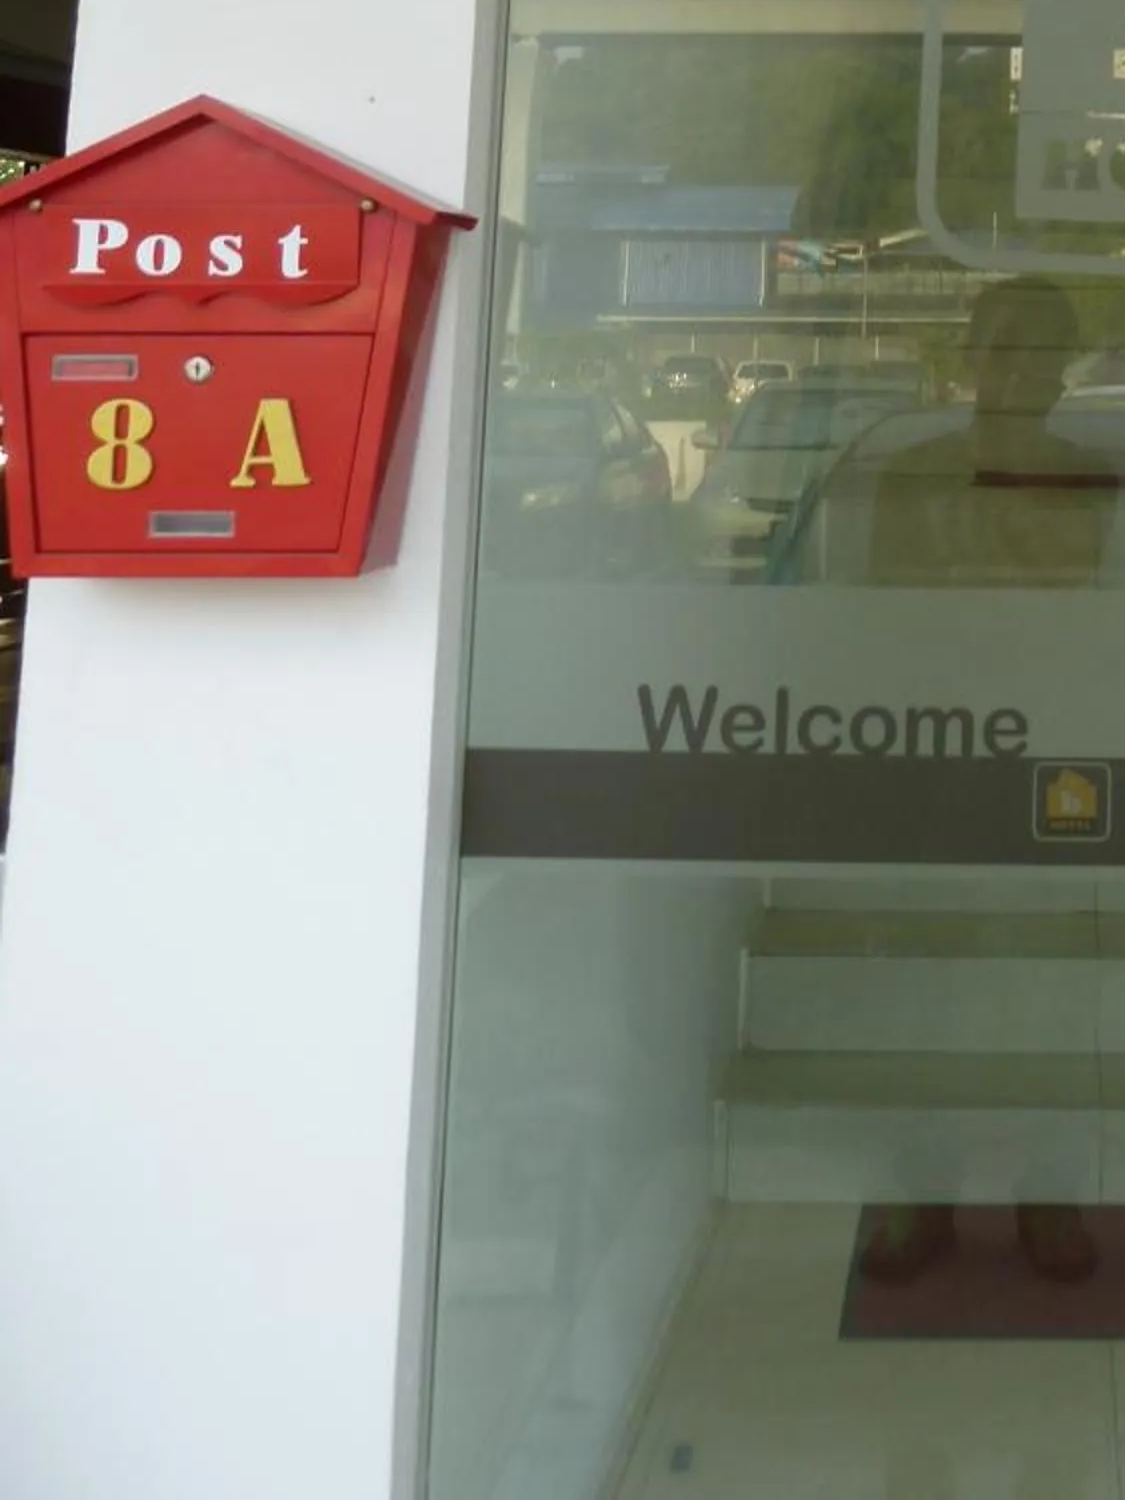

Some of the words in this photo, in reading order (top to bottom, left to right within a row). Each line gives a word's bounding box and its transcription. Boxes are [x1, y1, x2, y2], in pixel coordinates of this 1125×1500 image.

[69, 217, 310, 279] Post
[86, 398, 155, 489] 8
[229, 398, 312, 487] A
[637, 683, 1029, 758] Welcome
